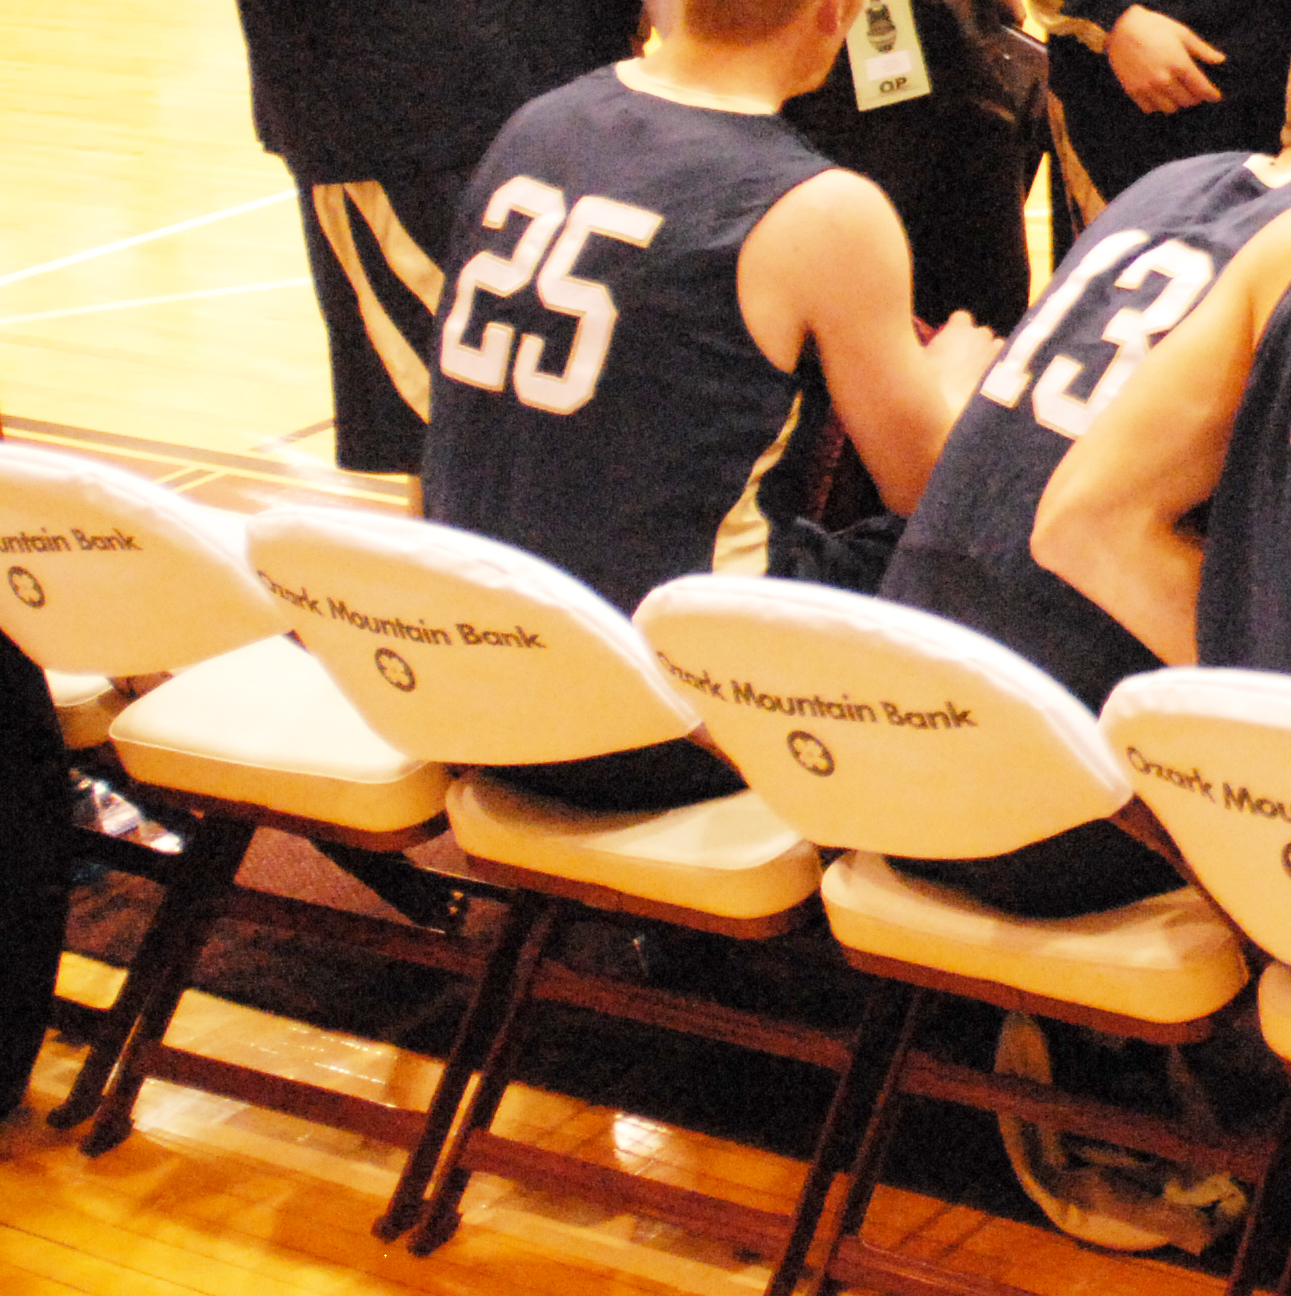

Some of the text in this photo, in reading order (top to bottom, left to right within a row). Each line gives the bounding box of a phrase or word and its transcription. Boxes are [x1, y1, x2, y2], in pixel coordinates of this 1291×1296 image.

[438, 172, 663, 420] 25
[979, 228, 1217, 442] 13
[70, 526, 144, 552] Bank
[326, 596, 452, 646] Mountain
[455, 622, 547, 649] Bank
[730, 678, 879, 724] Mountain
[879, 700, 977, 730] Bank
[1123, 743, 1217, 804] Ozark
